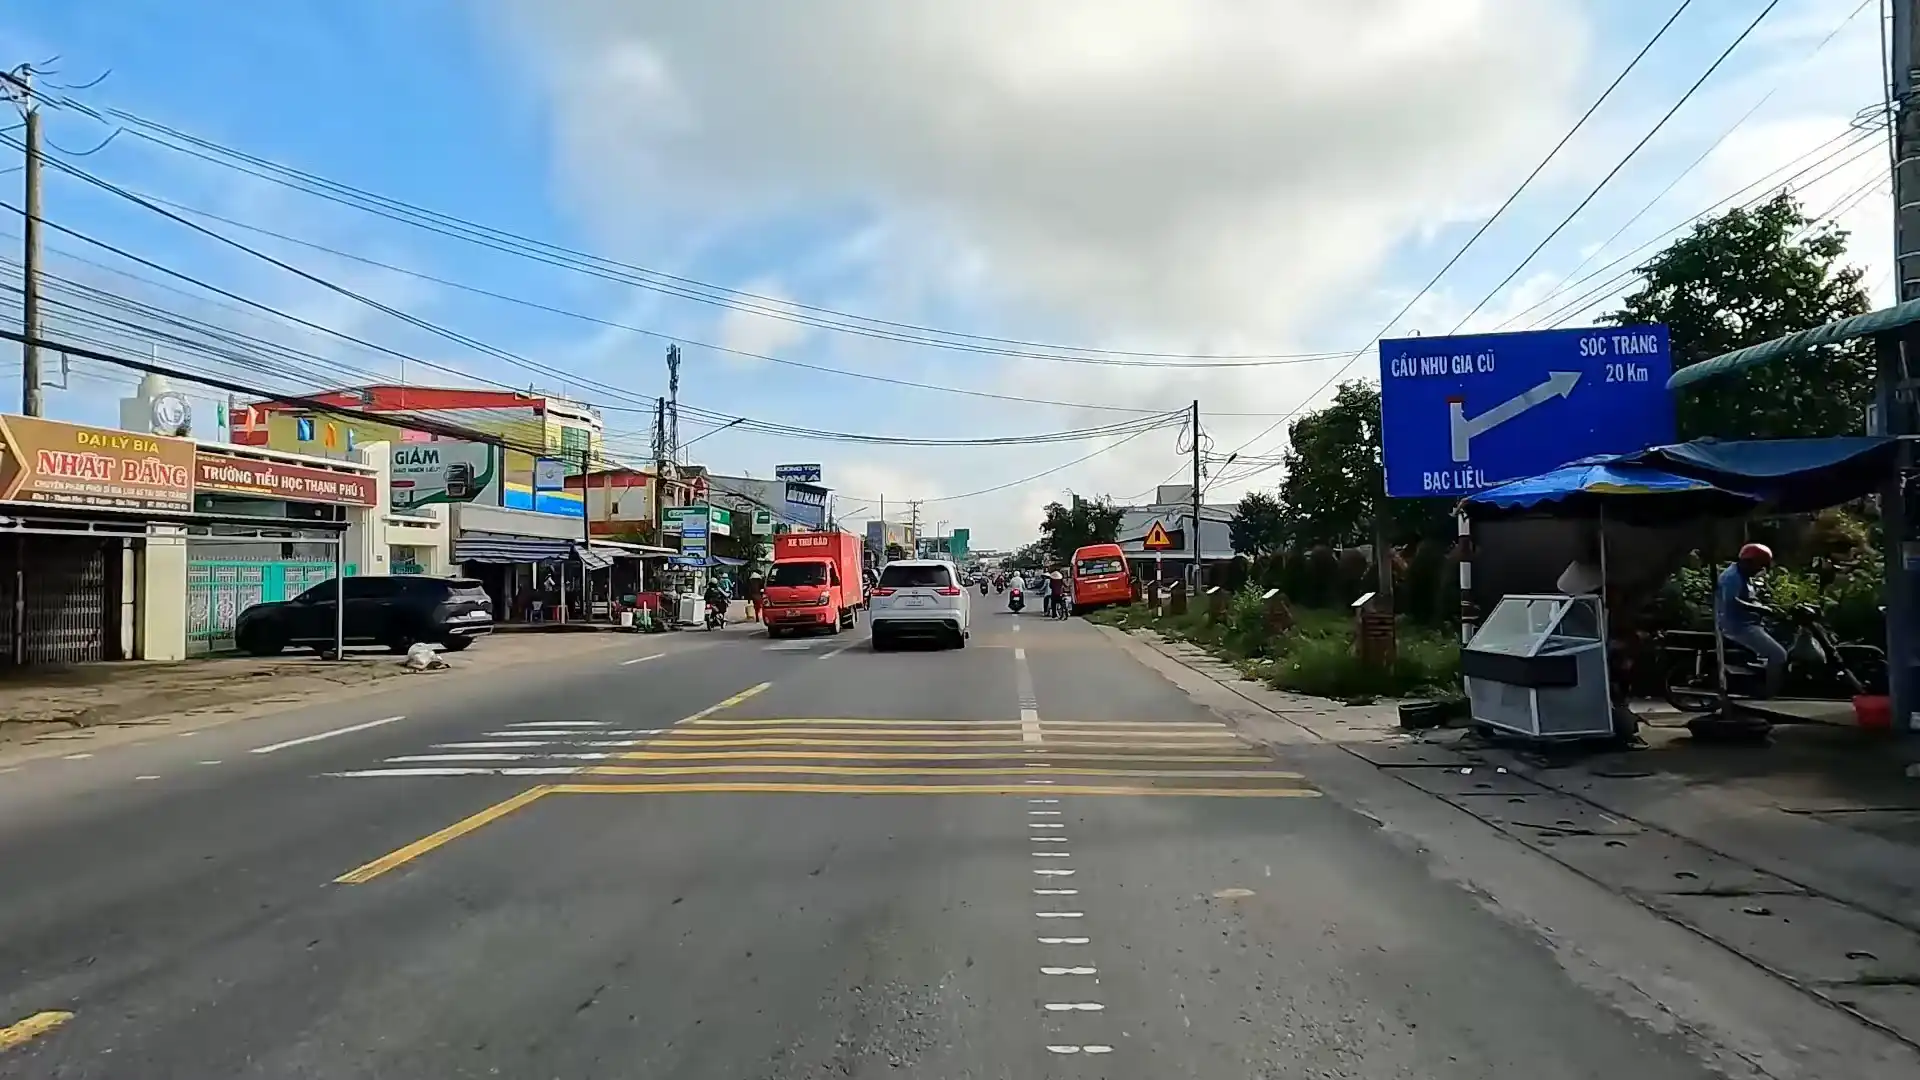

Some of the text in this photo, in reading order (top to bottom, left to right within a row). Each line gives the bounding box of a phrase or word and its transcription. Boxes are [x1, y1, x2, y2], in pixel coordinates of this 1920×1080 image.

[1579, 332, 1607, 356] SÓC
[1421, 356, 1448, 376] NHU
[1452, 354, 1474, 375] GIA
[1477, 349, 1495, 373] CŨ
[1605, 362, 1649, 383] 20 Km
[133, 439, 159, 454] BIA
[36, 449, 116, 480] NHẬT
[202, 464, 252, 485] TRƯỜNG
[254, 467, 279, 487] TIỂU
[281, 475, 304, 492] HỌC
[304, 478, 337, 495] THẠNH
[359, 485, 365, 498] 1
[1423, 470, 1450, 494] BẠC
